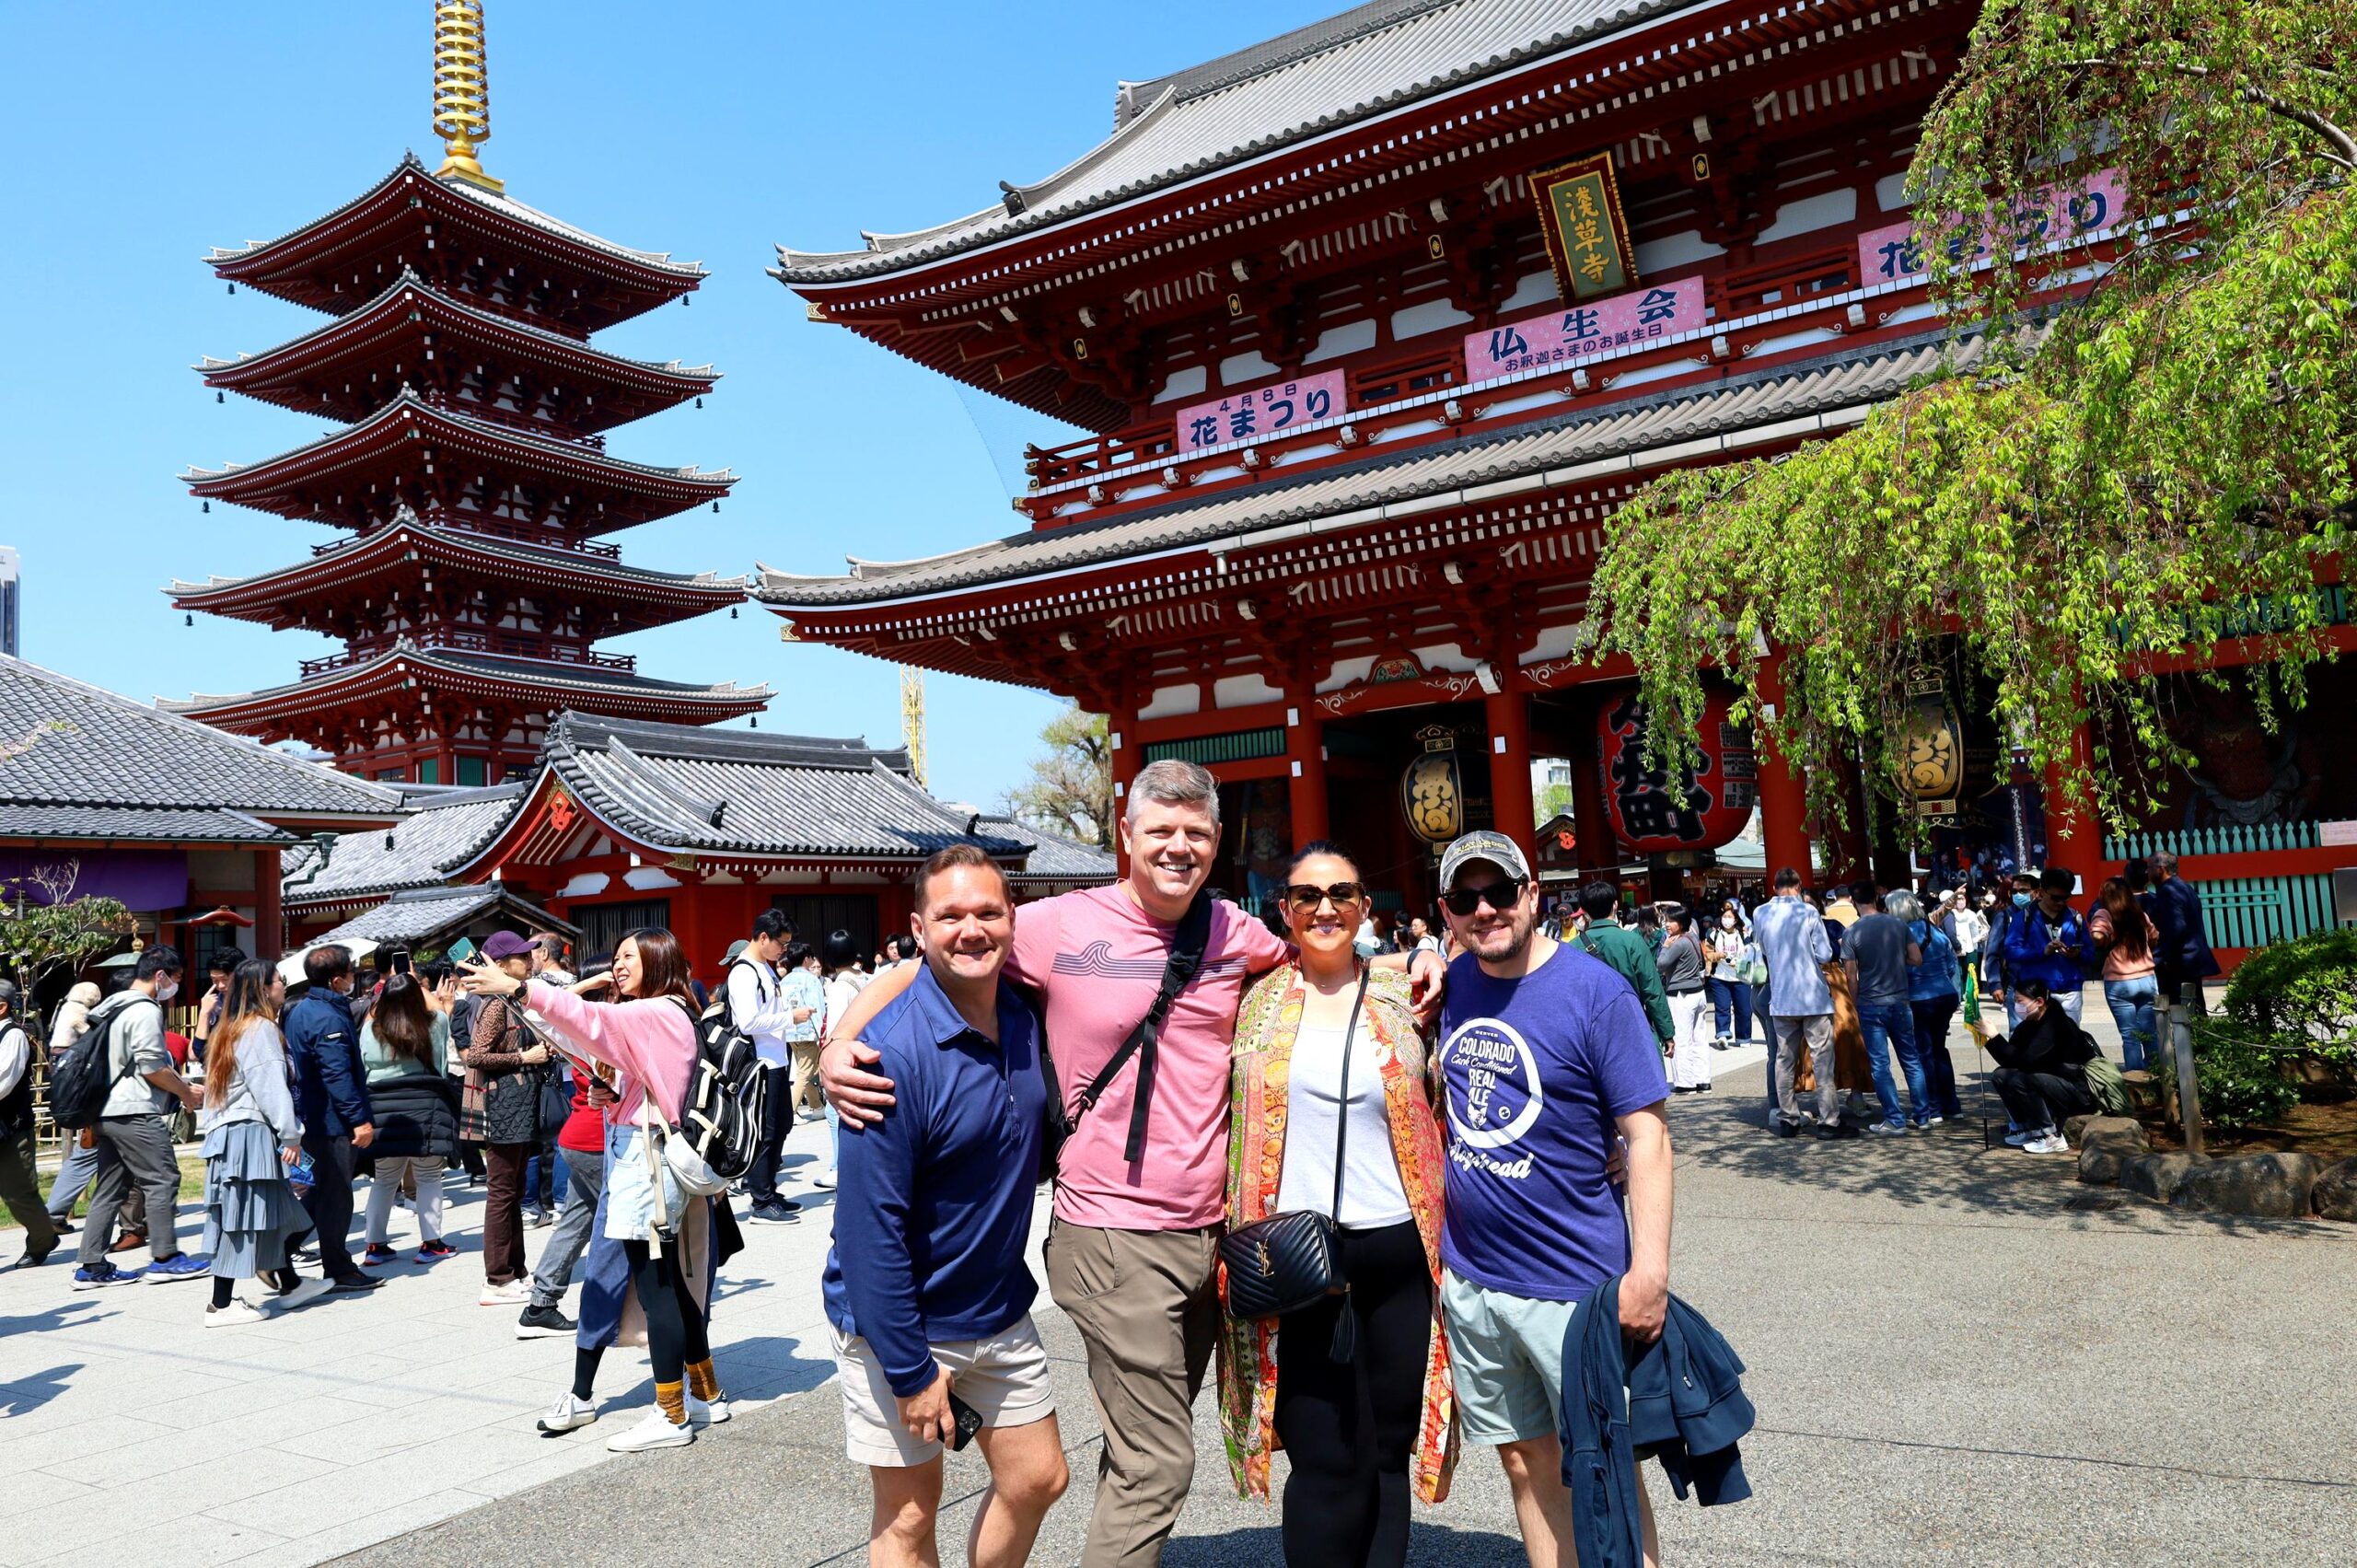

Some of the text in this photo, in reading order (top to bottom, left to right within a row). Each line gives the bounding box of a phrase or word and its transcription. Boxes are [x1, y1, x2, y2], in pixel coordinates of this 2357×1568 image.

[1487, 288, 1678, 363] 仏生会
[1504, 323, 1663, 373] お釈迦さまのお誕生日
[1190, 389, 1331, 447] 花まつり
[1458, 1037, 1515, 1063] COLORADO
[1450, 1053, 1518, 1075] Cask Conditioned
[1468, 1068, 1496, 1090] REAL
[1468, 1086, 1492, 1107] ALE
